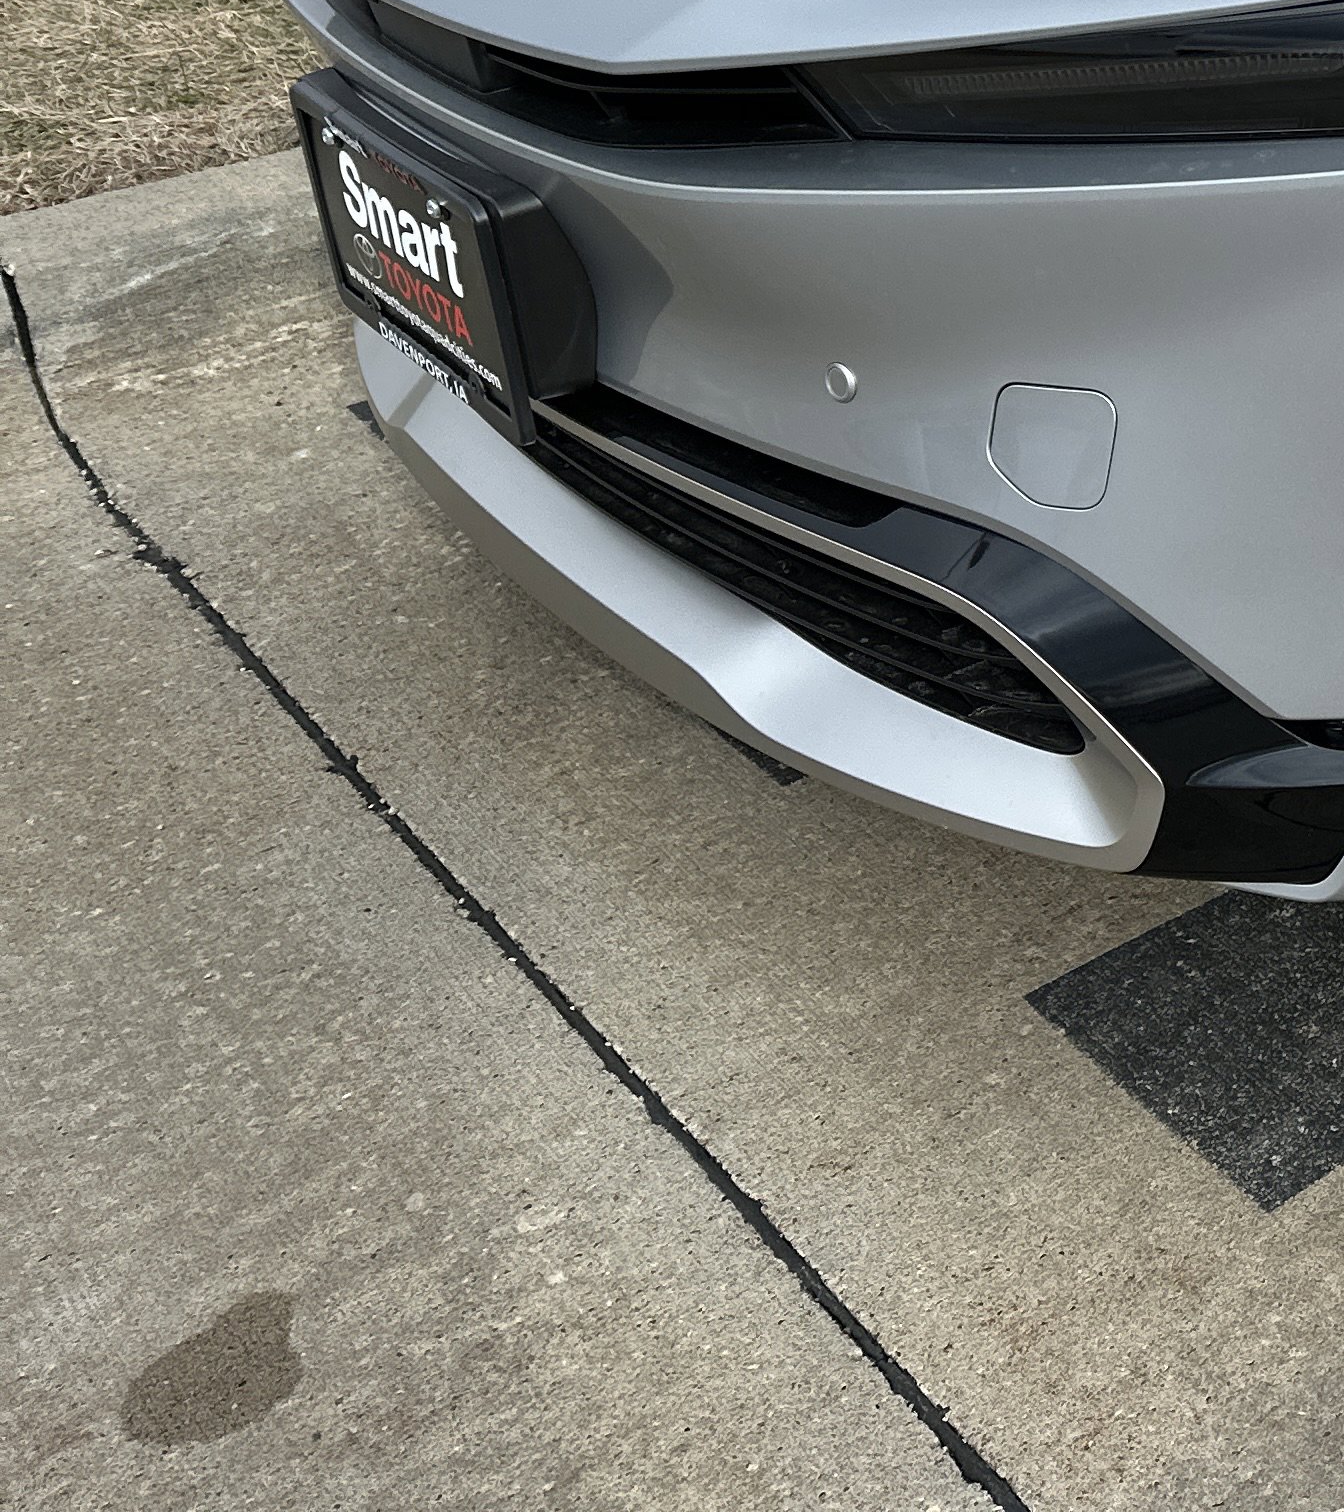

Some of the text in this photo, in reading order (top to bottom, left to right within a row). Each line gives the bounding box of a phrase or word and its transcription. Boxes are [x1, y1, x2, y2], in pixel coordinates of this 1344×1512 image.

[338, 150, 464, 299] Smart
[378, 250, 474, 347] TOYOTA
[453, 379, 469, 404] IA
